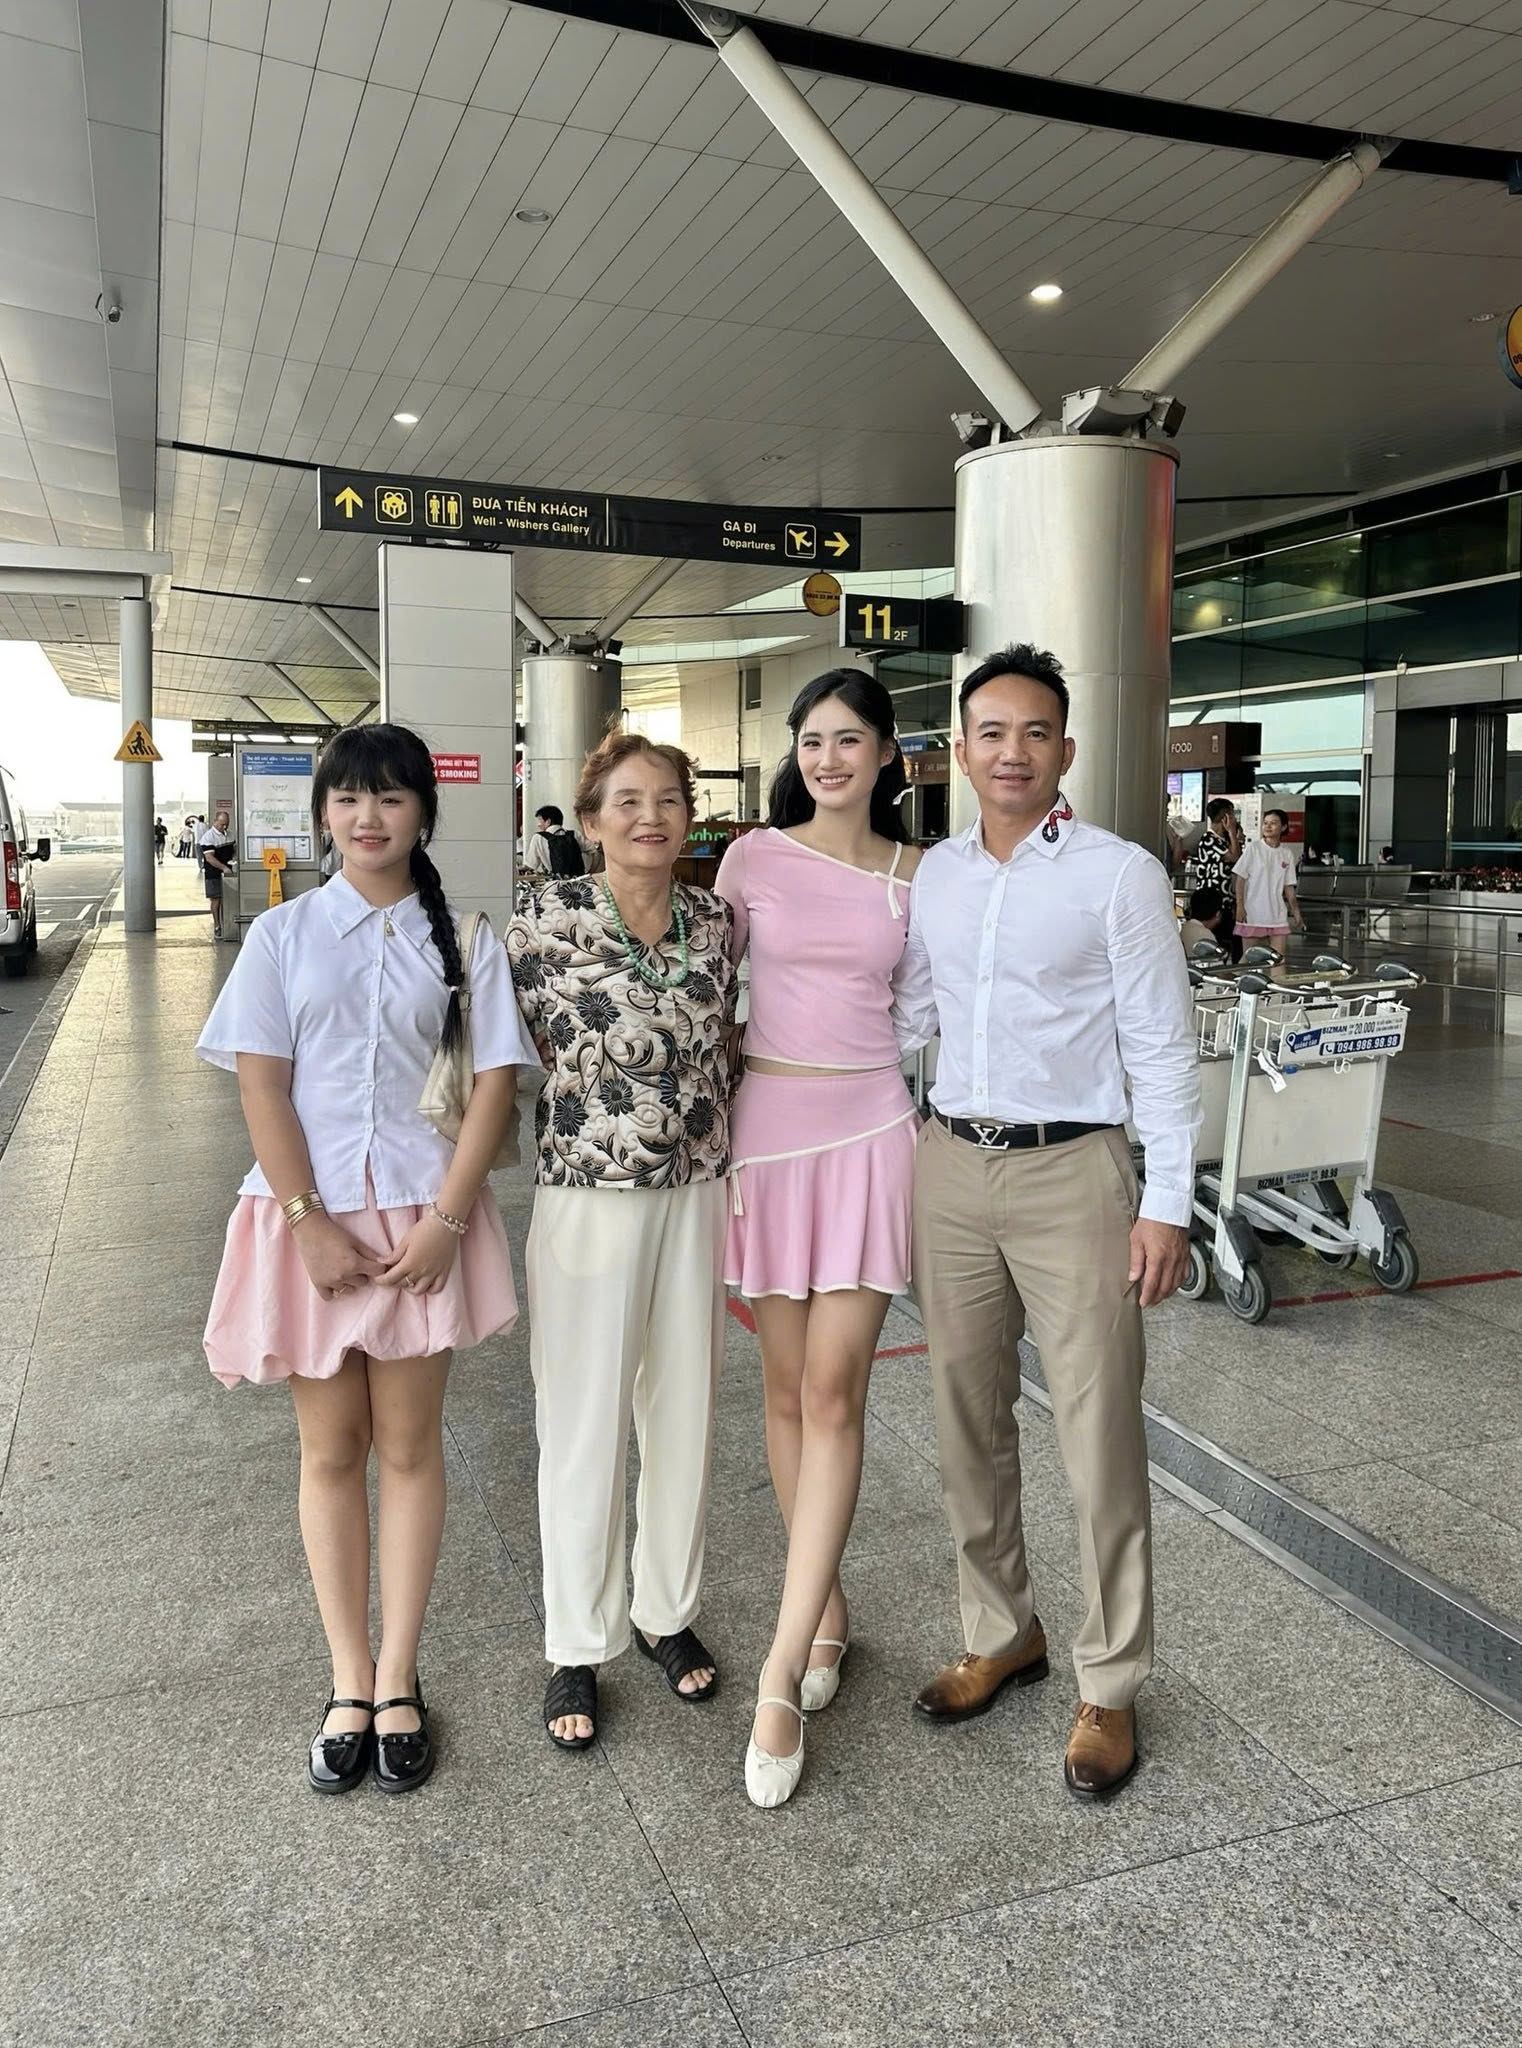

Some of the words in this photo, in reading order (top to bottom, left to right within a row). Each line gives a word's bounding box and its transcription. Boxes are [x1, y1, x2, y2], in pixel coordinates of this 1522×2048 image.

[472, 496, 502, 511] ĐƯA
[505, 495, 537, 513] TIỄN
[540, 501, 588, 518] KHÁCH
[472, 515, 496, 527] Well
[506, 517, 549, 531] Wishers
[552, 521, 590, 535] Gallery
[722, 520, 741, 533] GA
[744, 522, 757, 534] ĐI
[722, 537, 776, 551] Departures
[858, 603, 891, 640] 11
[893, 629, 909, 641] 2F
[1171, 742, 1193, 753] FOOD
[440, 769, 478, 779] SMOKING
[1337, 1035, 1398, 1053] 094.986.98.98
